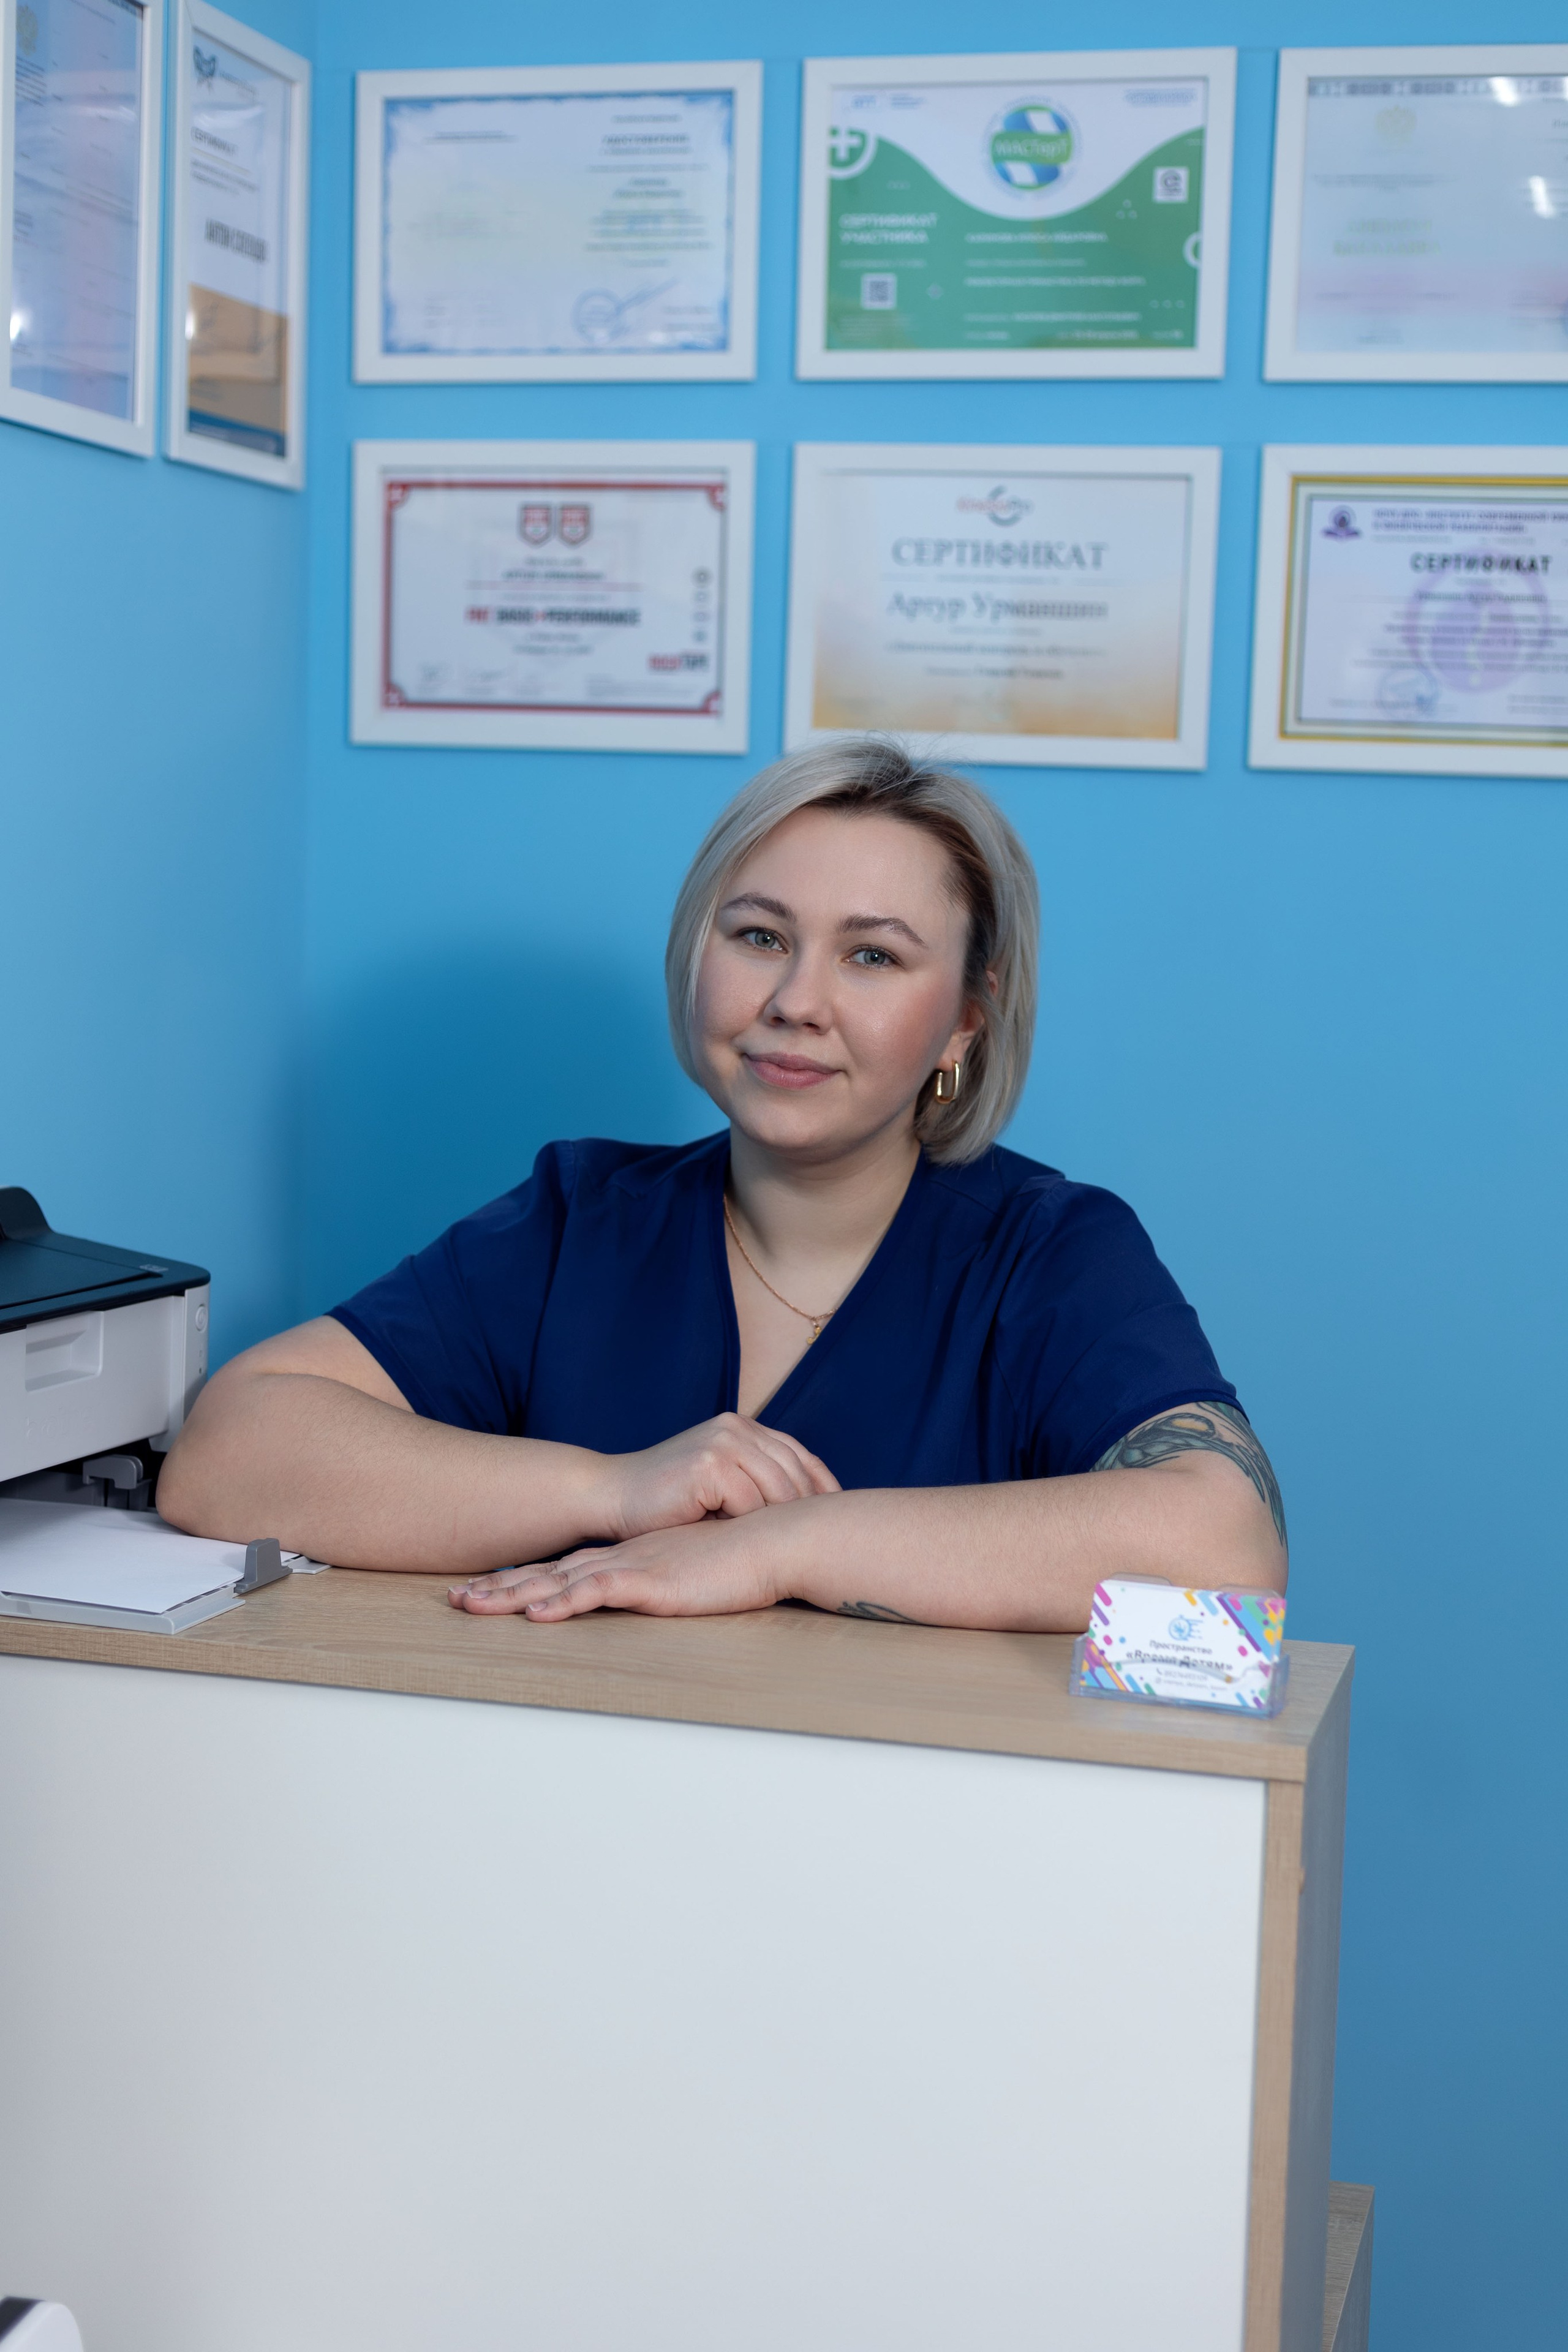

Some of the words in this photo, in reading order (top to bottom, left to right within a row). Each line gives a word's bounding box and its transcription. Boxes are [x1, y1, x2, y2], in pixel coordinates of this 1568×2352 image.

[891, 537, 1110, 570] СЕРТИФИКАТ
[1409, 552, 1552, 575] СЕРТИФИКАТ
[885, 590, 967, 624] Артур
[1150, 1640, 1212, 1654] Пространство
